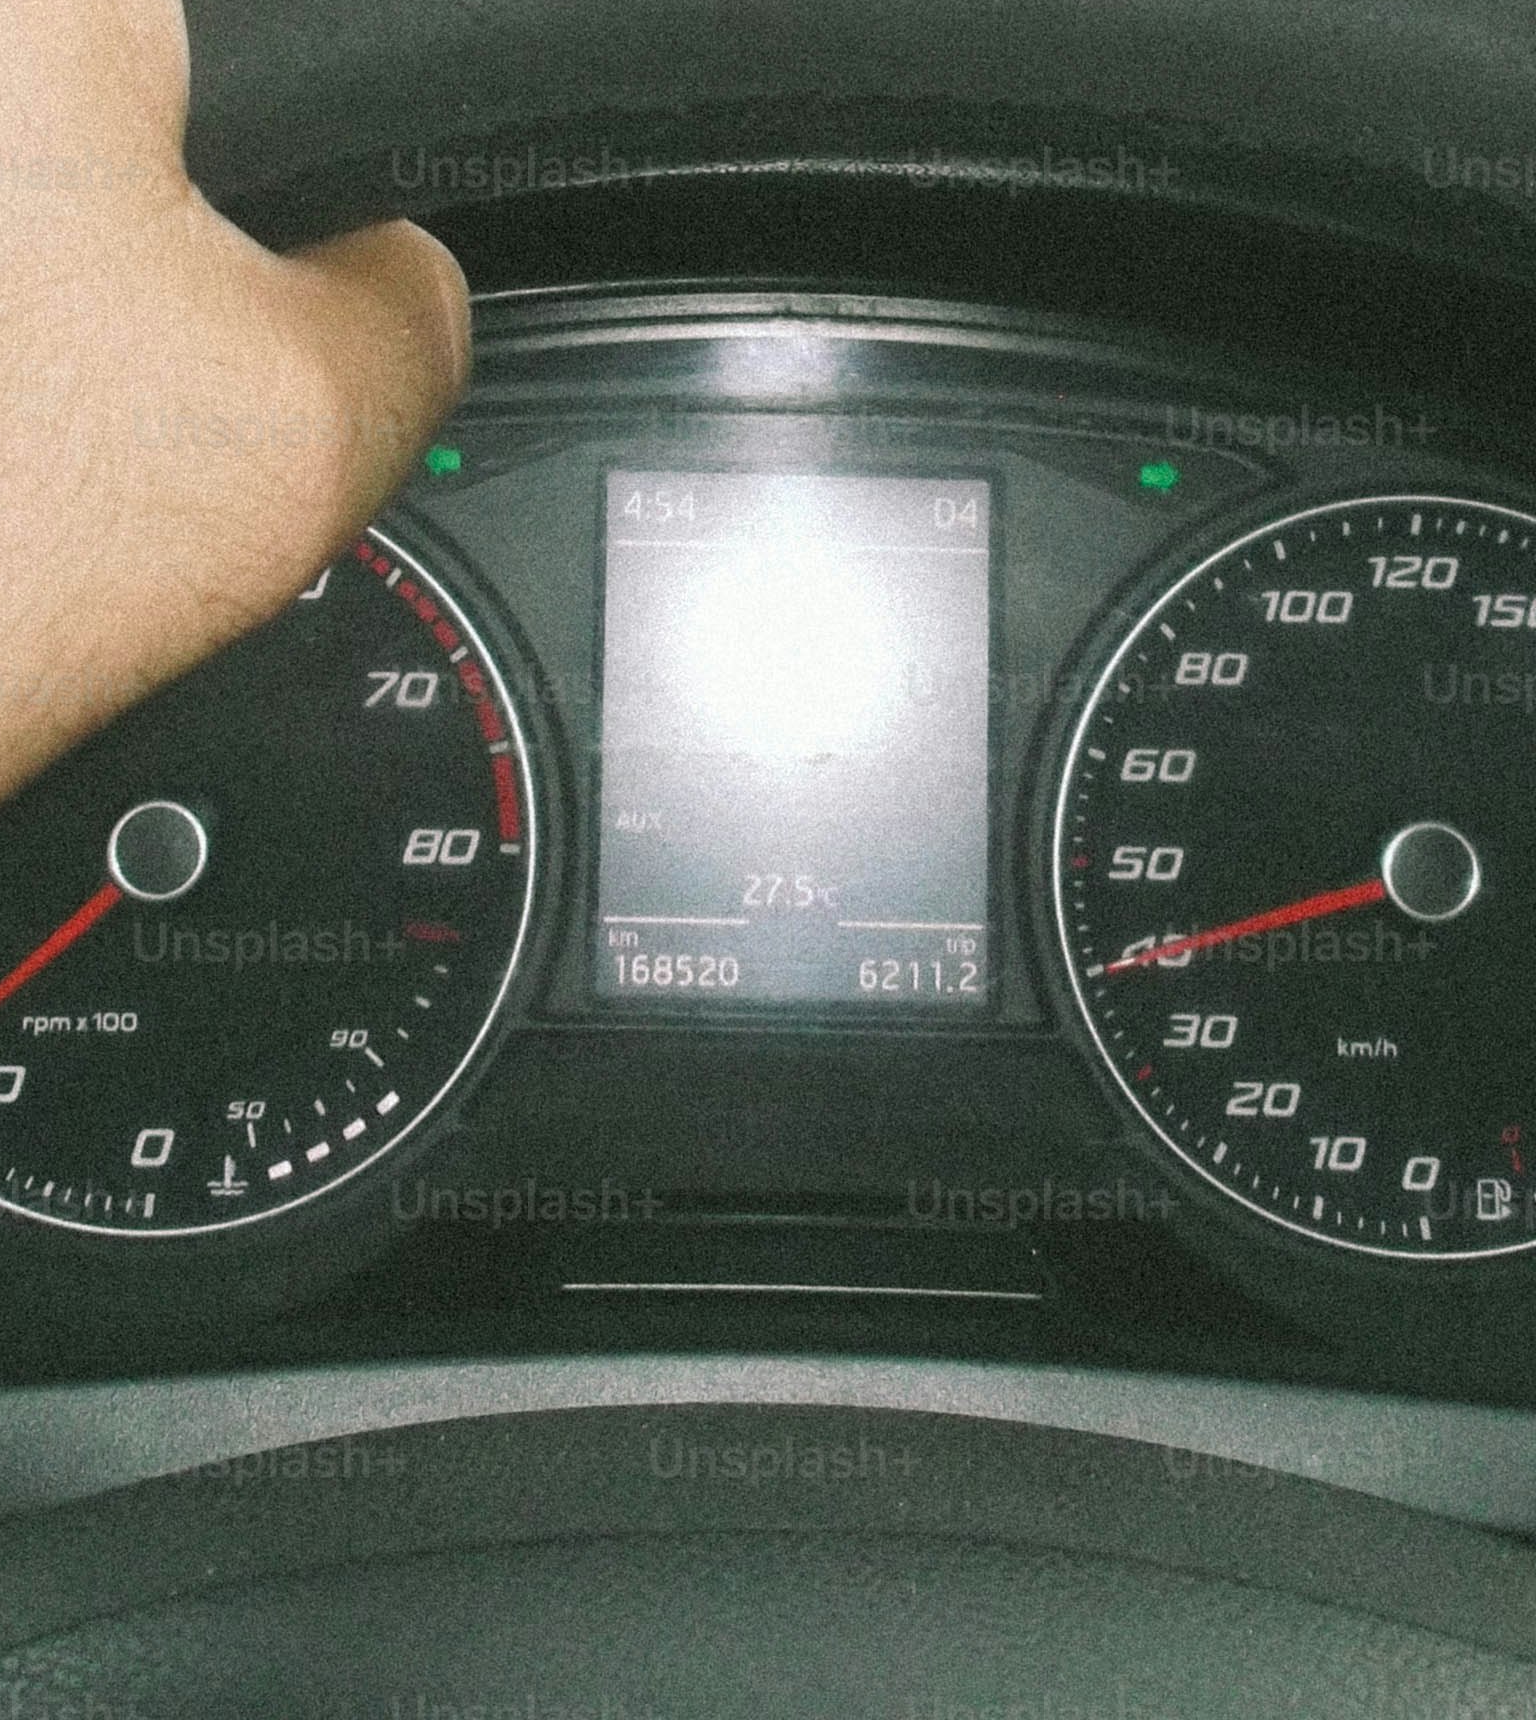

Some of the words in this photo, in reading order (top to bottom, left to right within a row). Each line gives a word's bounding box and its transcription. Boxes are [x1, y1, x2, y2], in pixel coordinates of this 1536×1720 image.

[623, 490, 696, 522] 4:54
[933, 496, 979, 529] 04
[1368, 555, 1459, 590] 120
[1261, 590, 1354, 624] 100
[1174, 652, 1249, 686] 80
[365, 670, 439, 709] 70
[1120, 748, 1197, 783] 60
[402, 828, 481, 865] 80
[1108, 845, 1184, 881] 50
[608, 930, 639, 947] km
[945, 935, 977, 955] trip
[615, 953, 741, 987] 168520
[858, 957, 978, 993] 6211.2
[22, 1016, 71, 1036] rpm
[329, 1029, 368, 1049] 90
[1163, 1013, 1238, 1049] 30
[1336, 1037, 1398, 1057] km/h
[226, 1100, 266, 1120] 50
[1225, 1081, 1302, 1117] 20
[130, 1128, 175, 1168] 0
[1310, 1136, 1367, 1172] 10
[1401, 1156, 1440, 1192] 0
